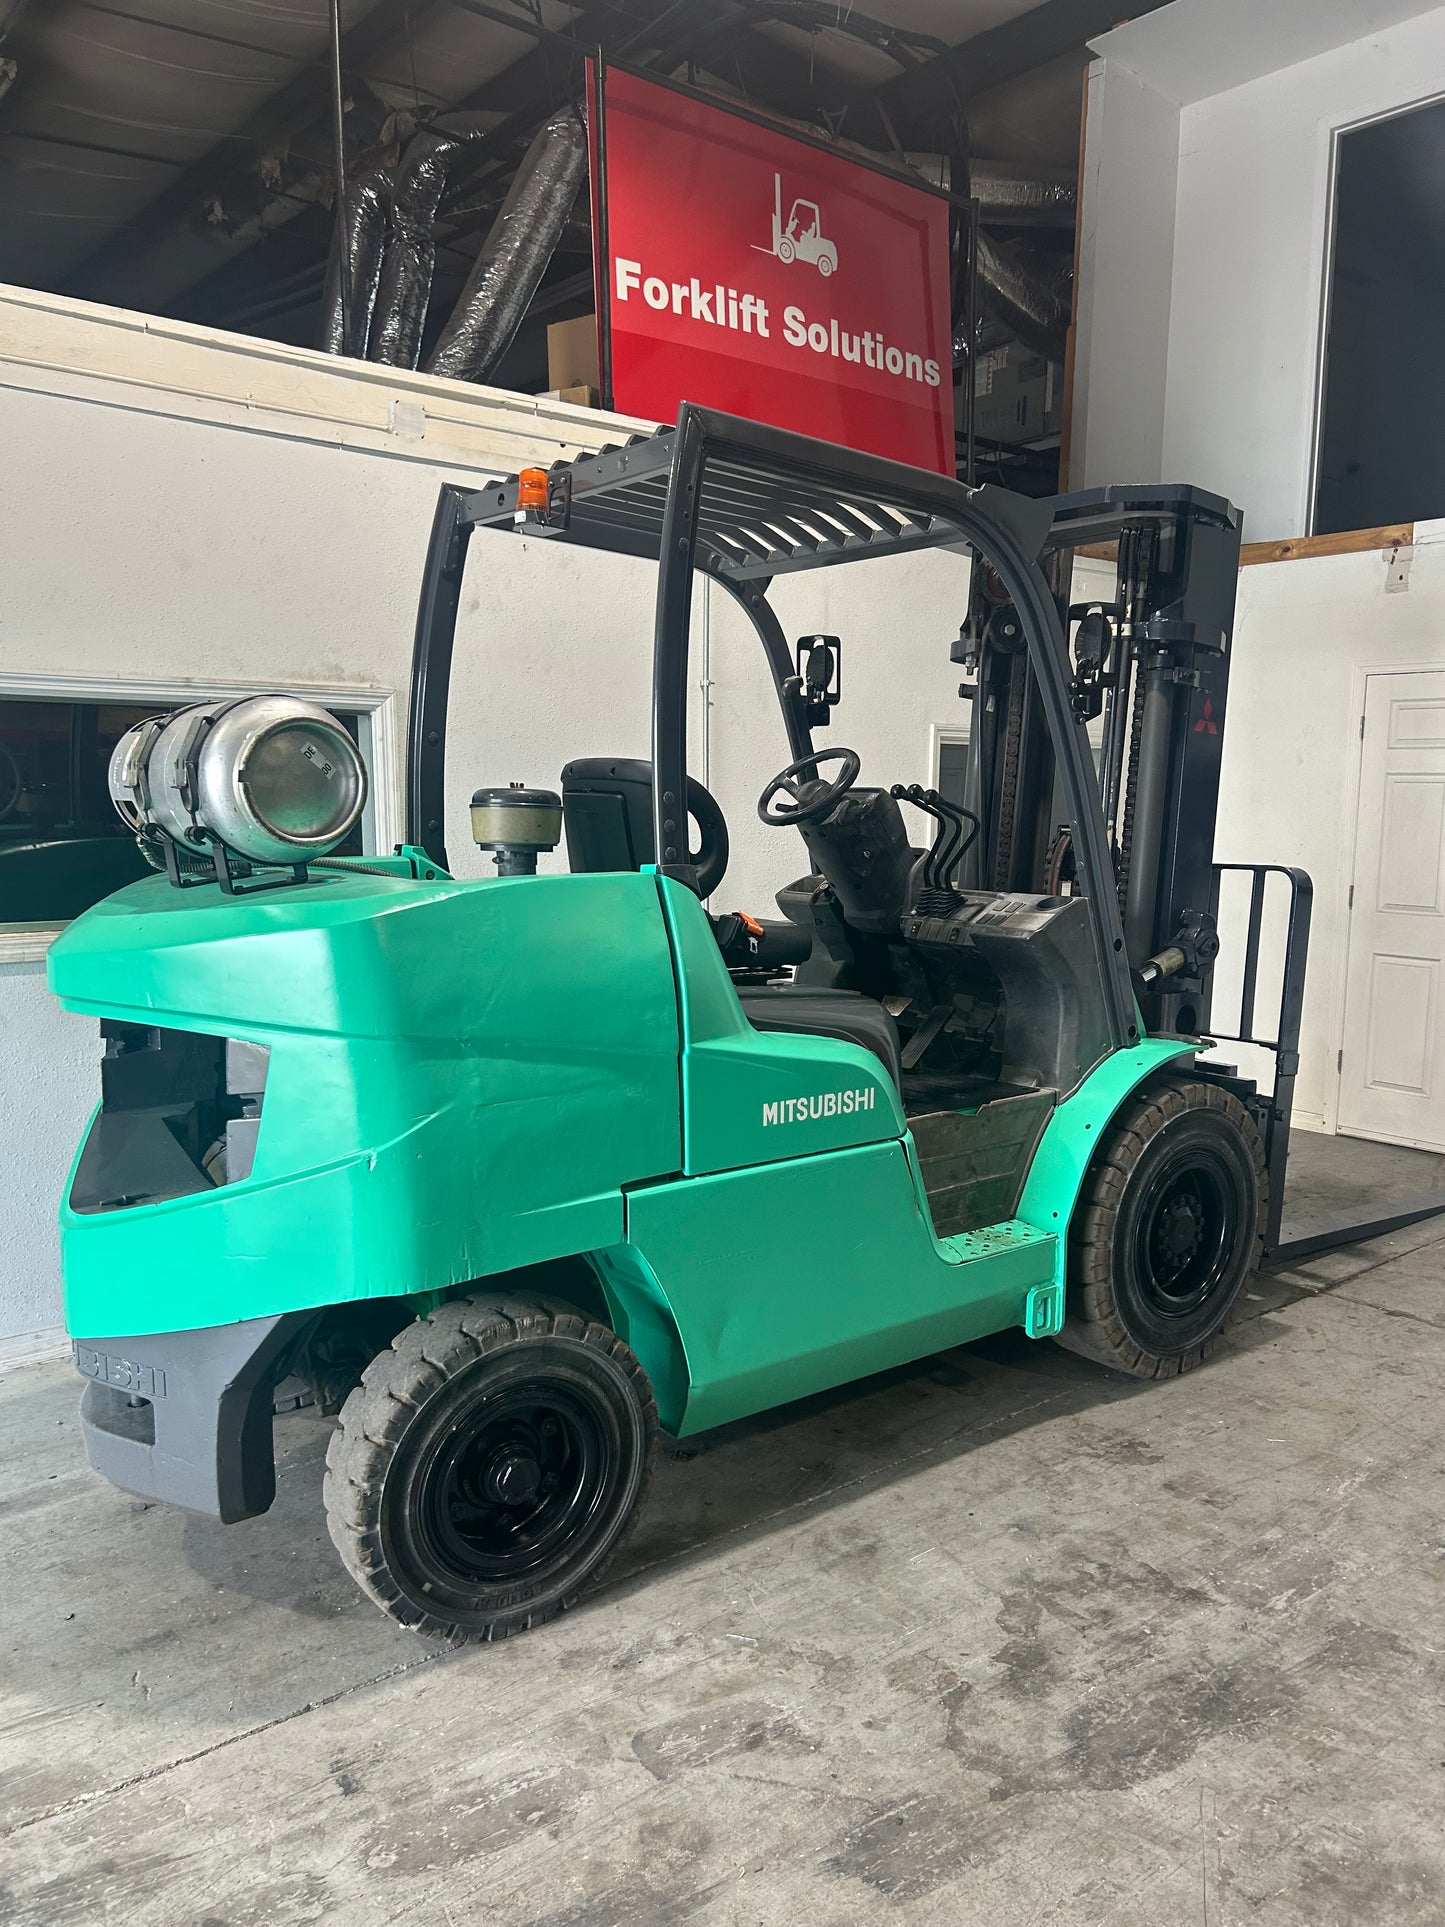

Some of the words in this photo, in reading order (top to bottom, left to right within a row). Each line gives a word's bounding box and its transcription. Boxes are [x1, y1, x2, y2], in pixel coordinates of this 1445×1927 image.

[615, 257, 770, 338] Forklift
[783, 306, 941, 388] Solutions
[303, 746, 316, 760] DE
[762, 1087, 875, 1127] MITSUBISHI
